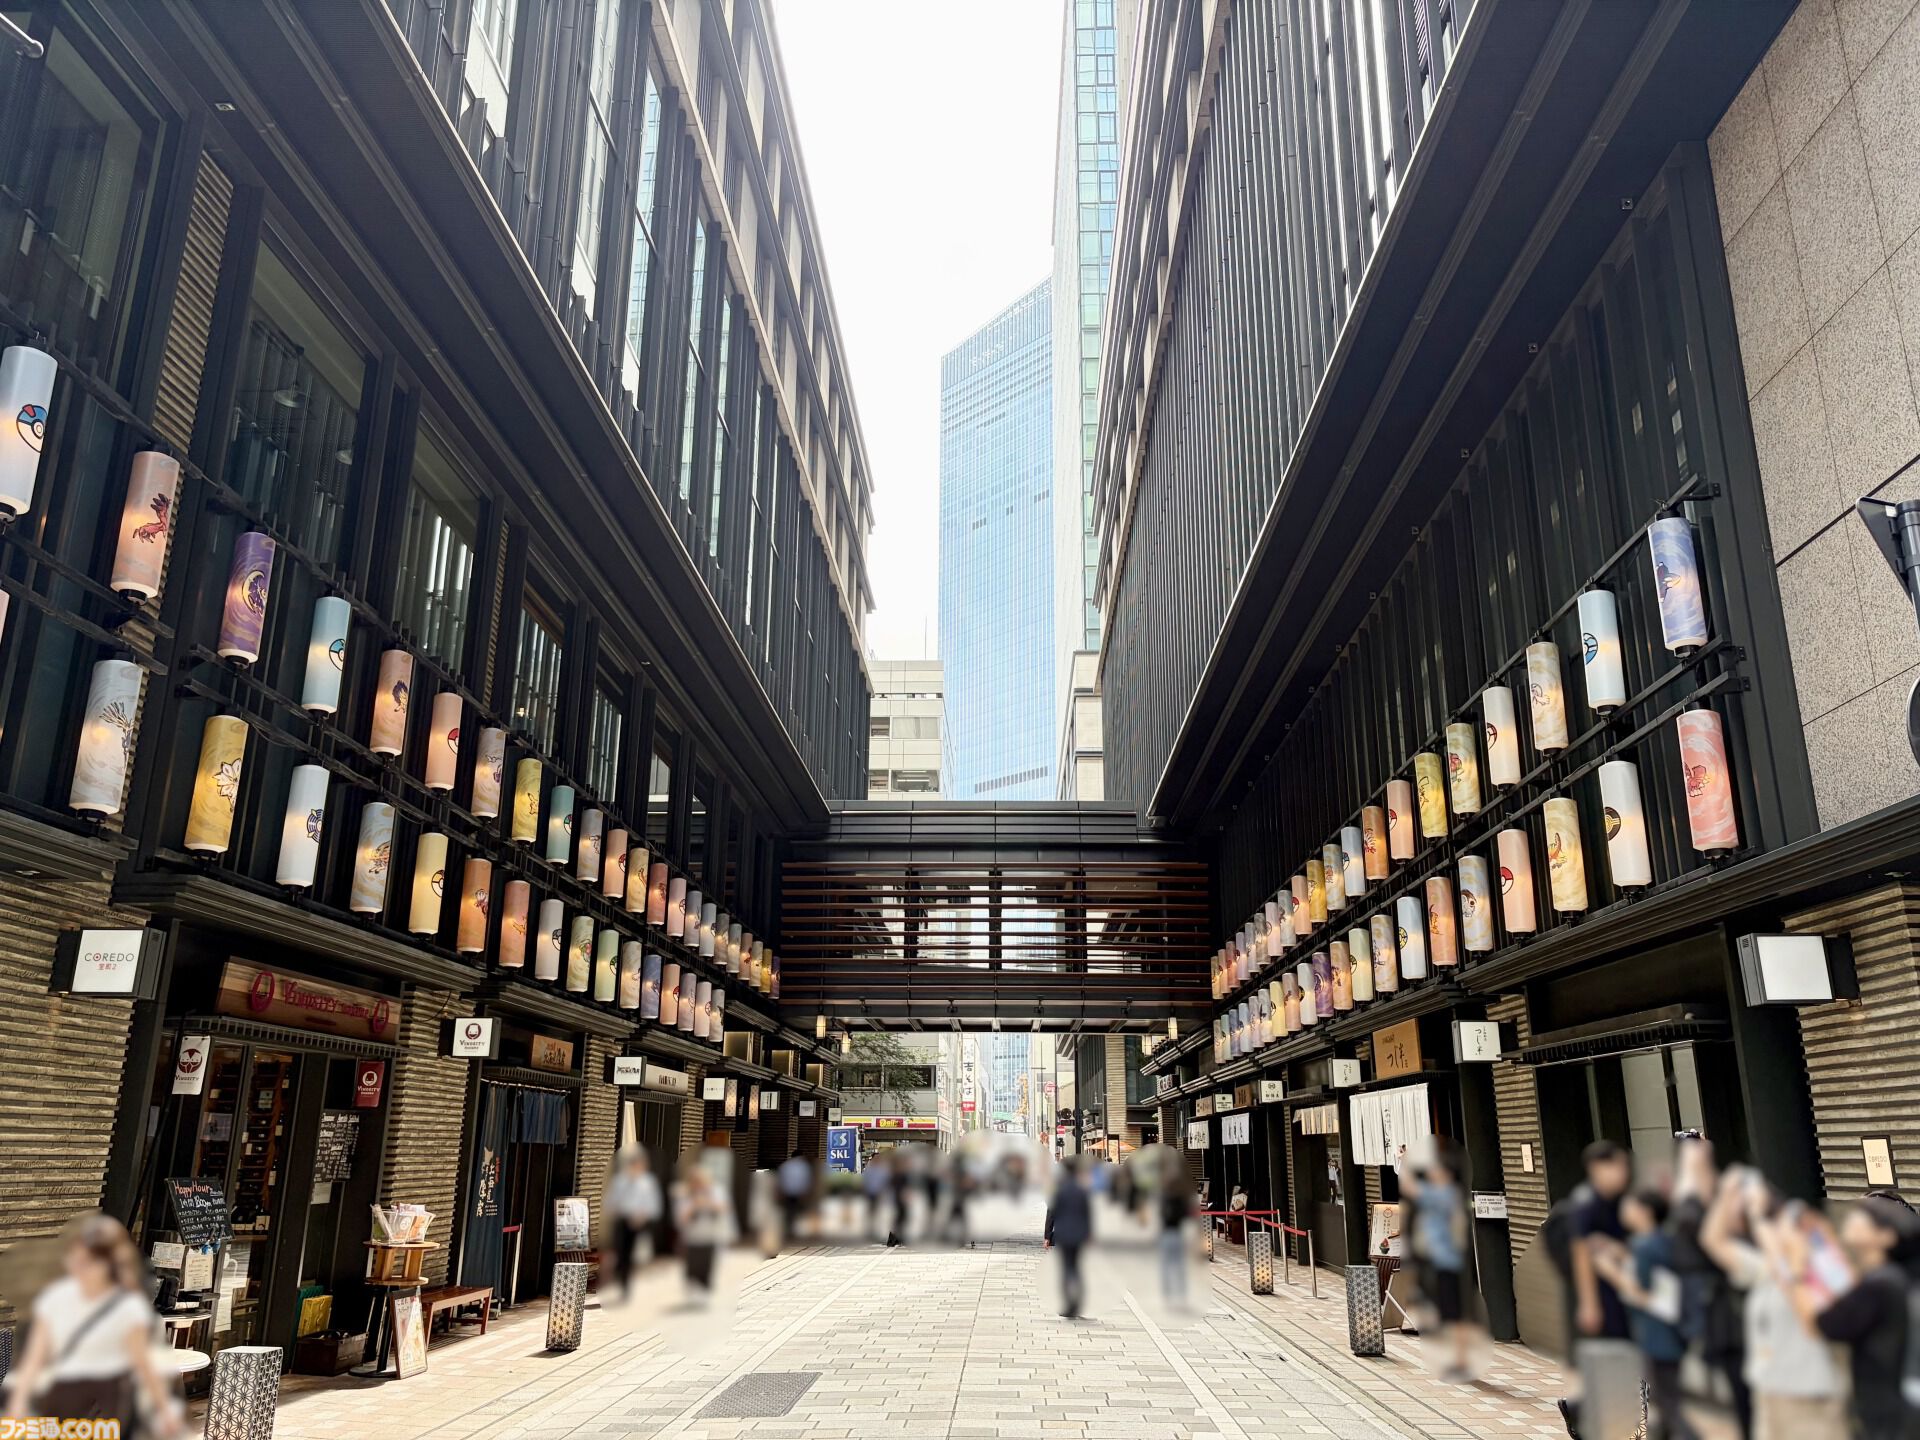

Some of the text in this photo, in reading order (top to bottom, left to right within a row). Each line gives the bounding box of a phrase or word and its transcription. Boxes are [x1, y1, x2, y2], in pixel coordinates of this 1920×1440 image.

[84, 952, 135, 962] COREDO
[830, 1149, 850, 1159] SKL
[191, 1180, 210, 1194] Hour
